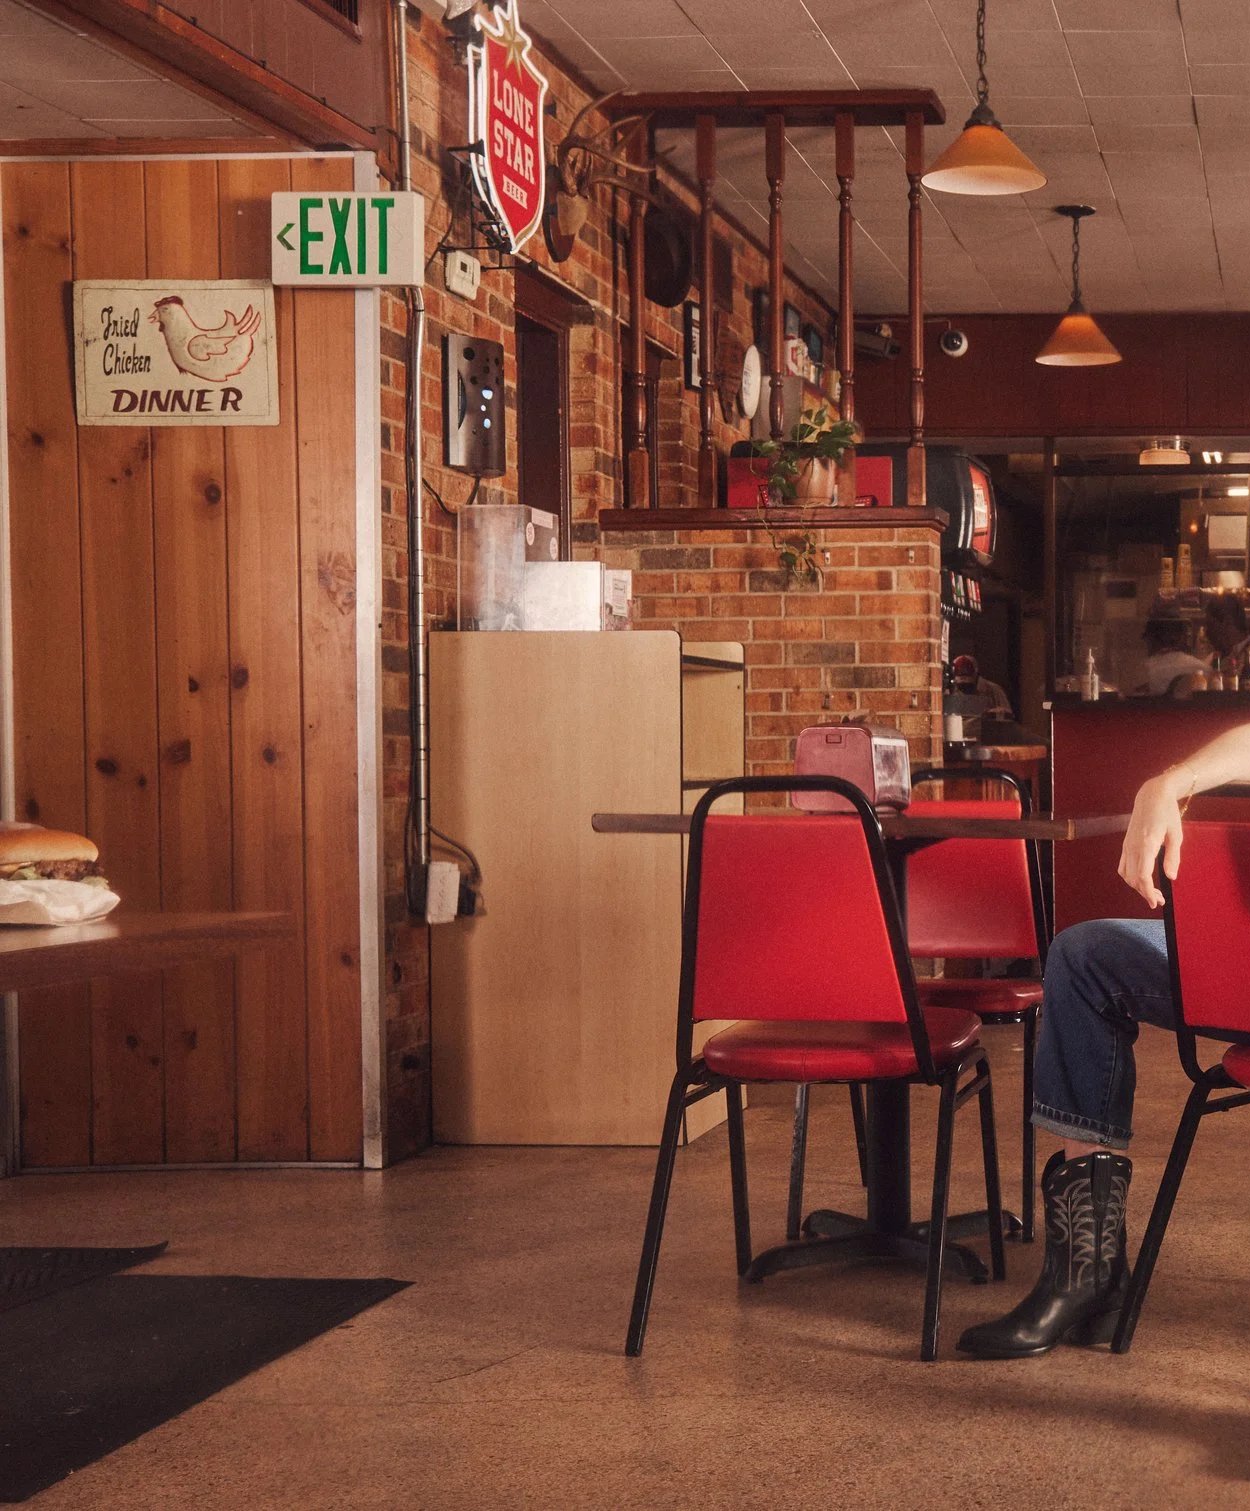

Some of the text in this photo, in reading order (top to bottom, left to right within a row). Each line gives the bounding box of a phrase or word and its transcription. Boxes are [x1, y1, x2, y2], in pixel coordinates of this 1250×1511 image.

[493, 69, 534, 139] LONE
[493, 119, 535, 185] STAR
[505, 180, 526, 205] BEER
[300, 198, 395, 275] EXIT
[101, 306, 140, 341] Fried
[103, 343, 151, 376] Chicken
[111, 387, 243, 412] DINNER
